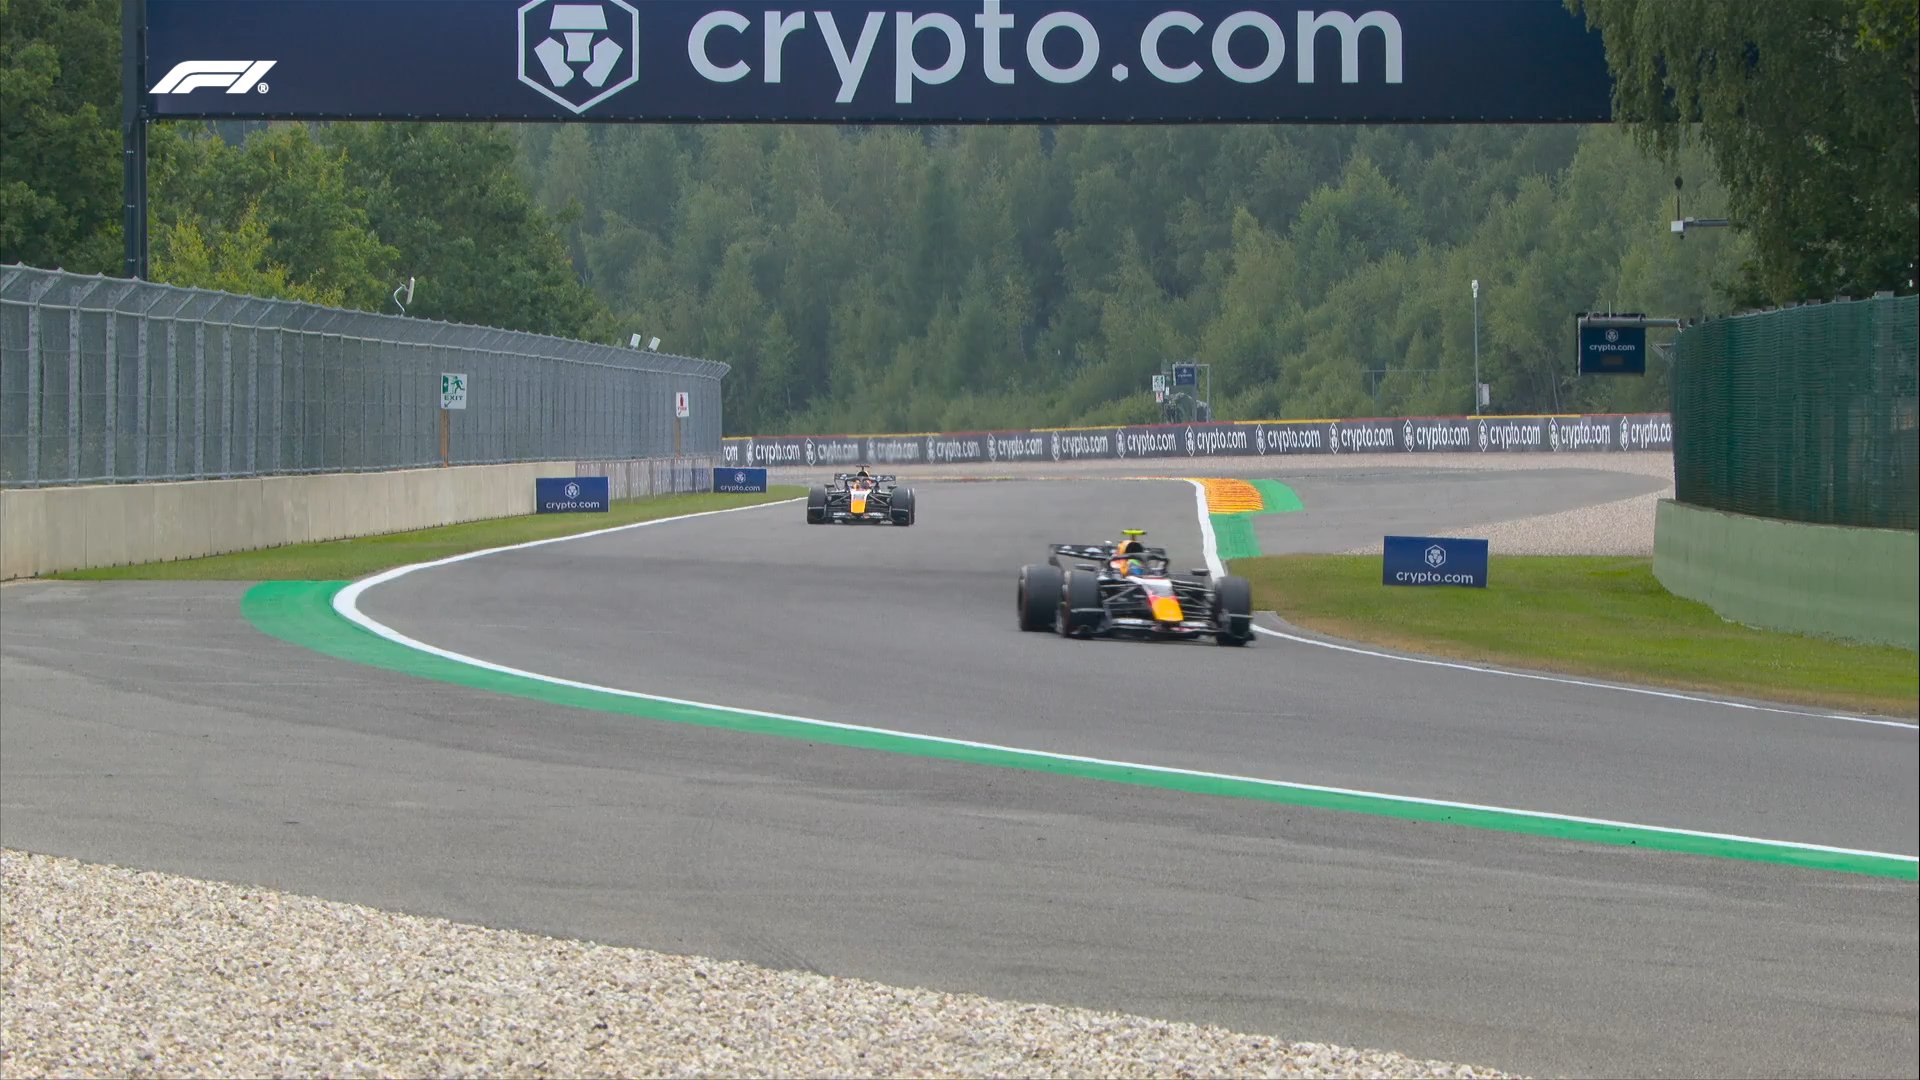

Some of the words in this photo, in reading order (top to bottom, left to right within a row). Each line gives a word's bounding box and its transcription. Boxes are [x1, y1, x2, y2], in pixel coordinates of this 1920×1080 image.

[688, 0, 1402, 103] crypto.com
[1589, 344, 1636, 352] crypto.com
[1062, 433, 1108, 458] crypto.com
[1127, 430, 1177, 456] crypto.com
[1197, 428, 1248, 453] crypto.com
[1267, 427, 1321, 452] crypto.com
[1341, 425, 1395, 452] crypto.com
[1416, 423, 1470, 450] crypto.com
[1490, 421, 1541, 449] crypto.com
[1561, 421, 1611, 449] crypto.com
[1631, 418, 1673, 449] crypto.co
[755, 441, 800, 465] crypto.com
[936, 437, 980, 461] crypto.com
[998, 435, 1042, 459] crypto.com
[720, 484, 760, 492] crypto.com
[546, 500, 600, 510] crypto.com
[1396, 571, 1474, 584] crypto.com
